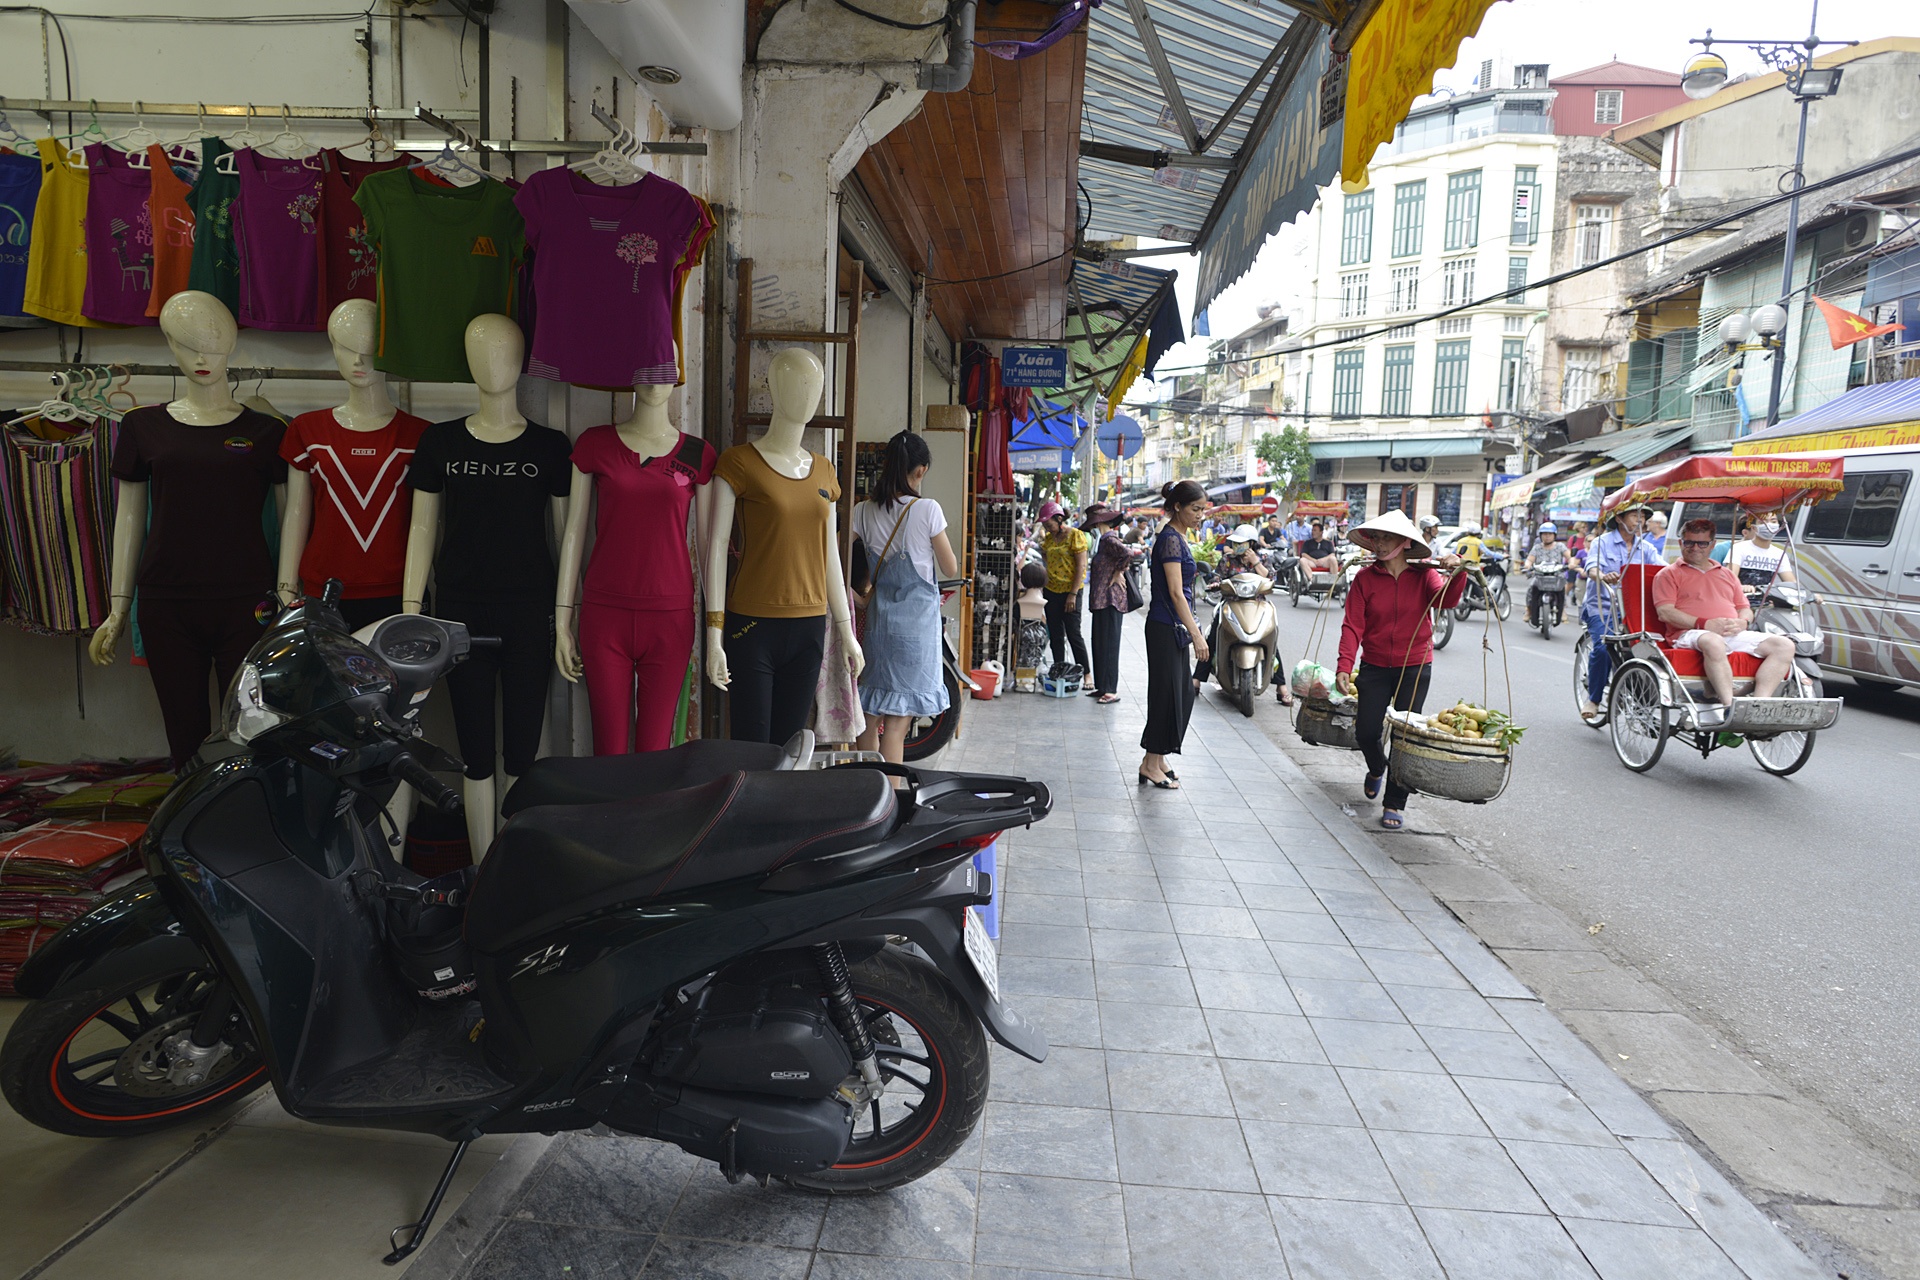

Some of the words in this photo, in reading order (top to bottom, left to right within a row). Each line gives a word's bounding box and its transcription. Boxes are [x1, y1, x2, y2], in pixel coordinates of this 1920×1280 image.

[1016, 353, 1054, 366] Xuân
[1018, 367, 1037, 377] HÀNG
[1038, 367, 1062, 378] ĐƯỜNG
[445, 461, 538, 478] KENZO
[1377, 456, 1427, 472] TQQ
[1725, 460, 1746, 472] LAM
[1748, 460, 1769, 472] ANH
[506, 943, 569, 981] SH
